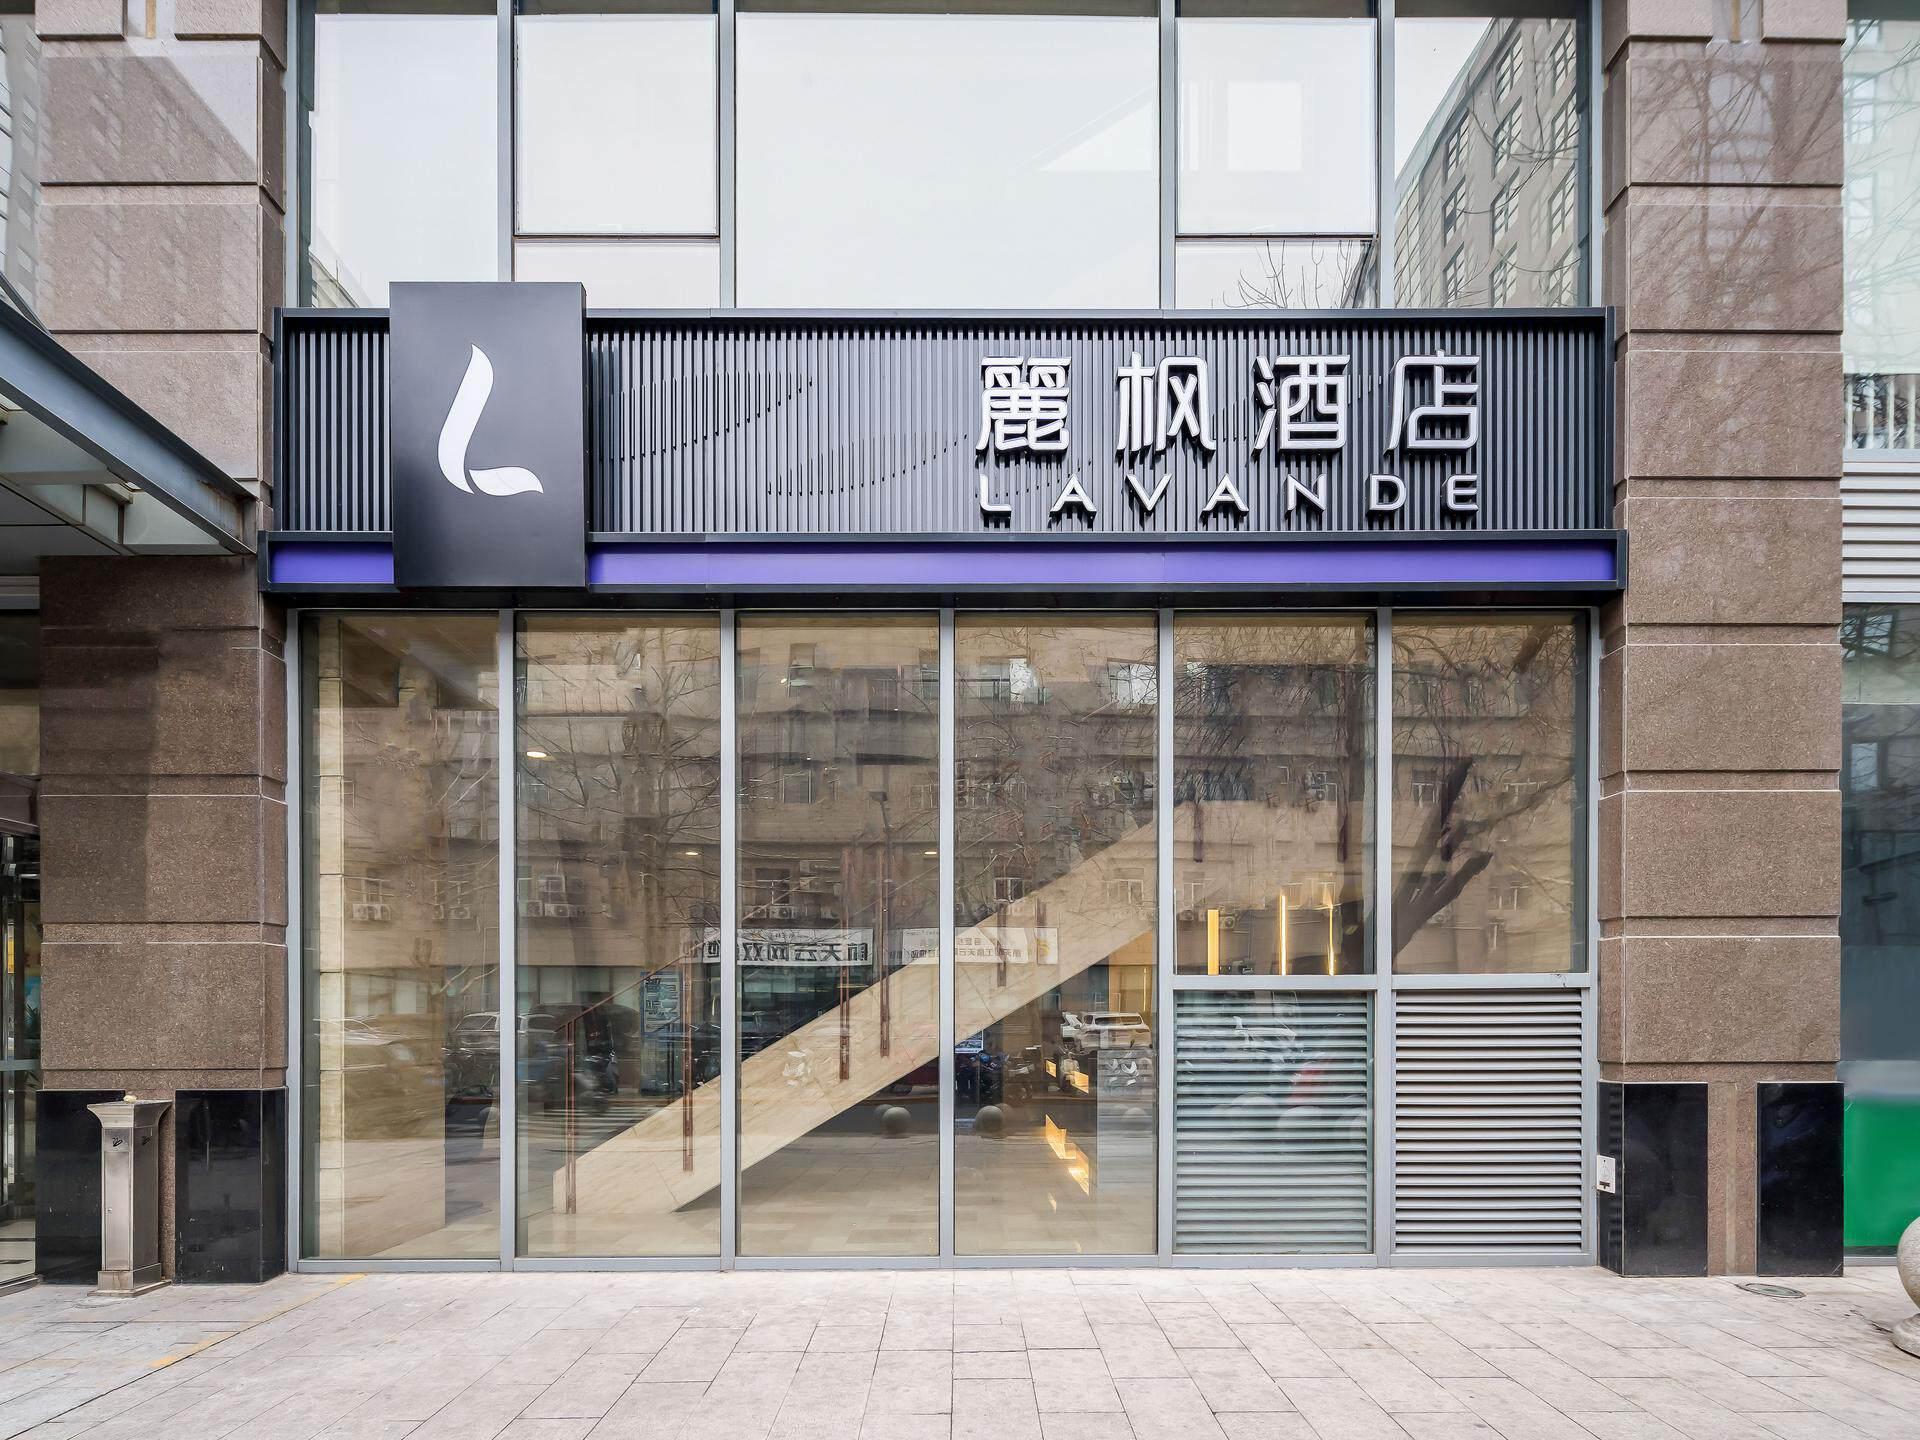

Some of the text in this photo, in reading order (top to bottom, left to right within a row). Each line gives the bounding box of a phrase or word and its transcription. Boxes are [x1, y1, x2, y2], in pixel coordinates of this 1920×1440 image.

[976, 351, 1481, 453] 麗枫酒店
[979, 473, 1478, 513] LAVANDE
